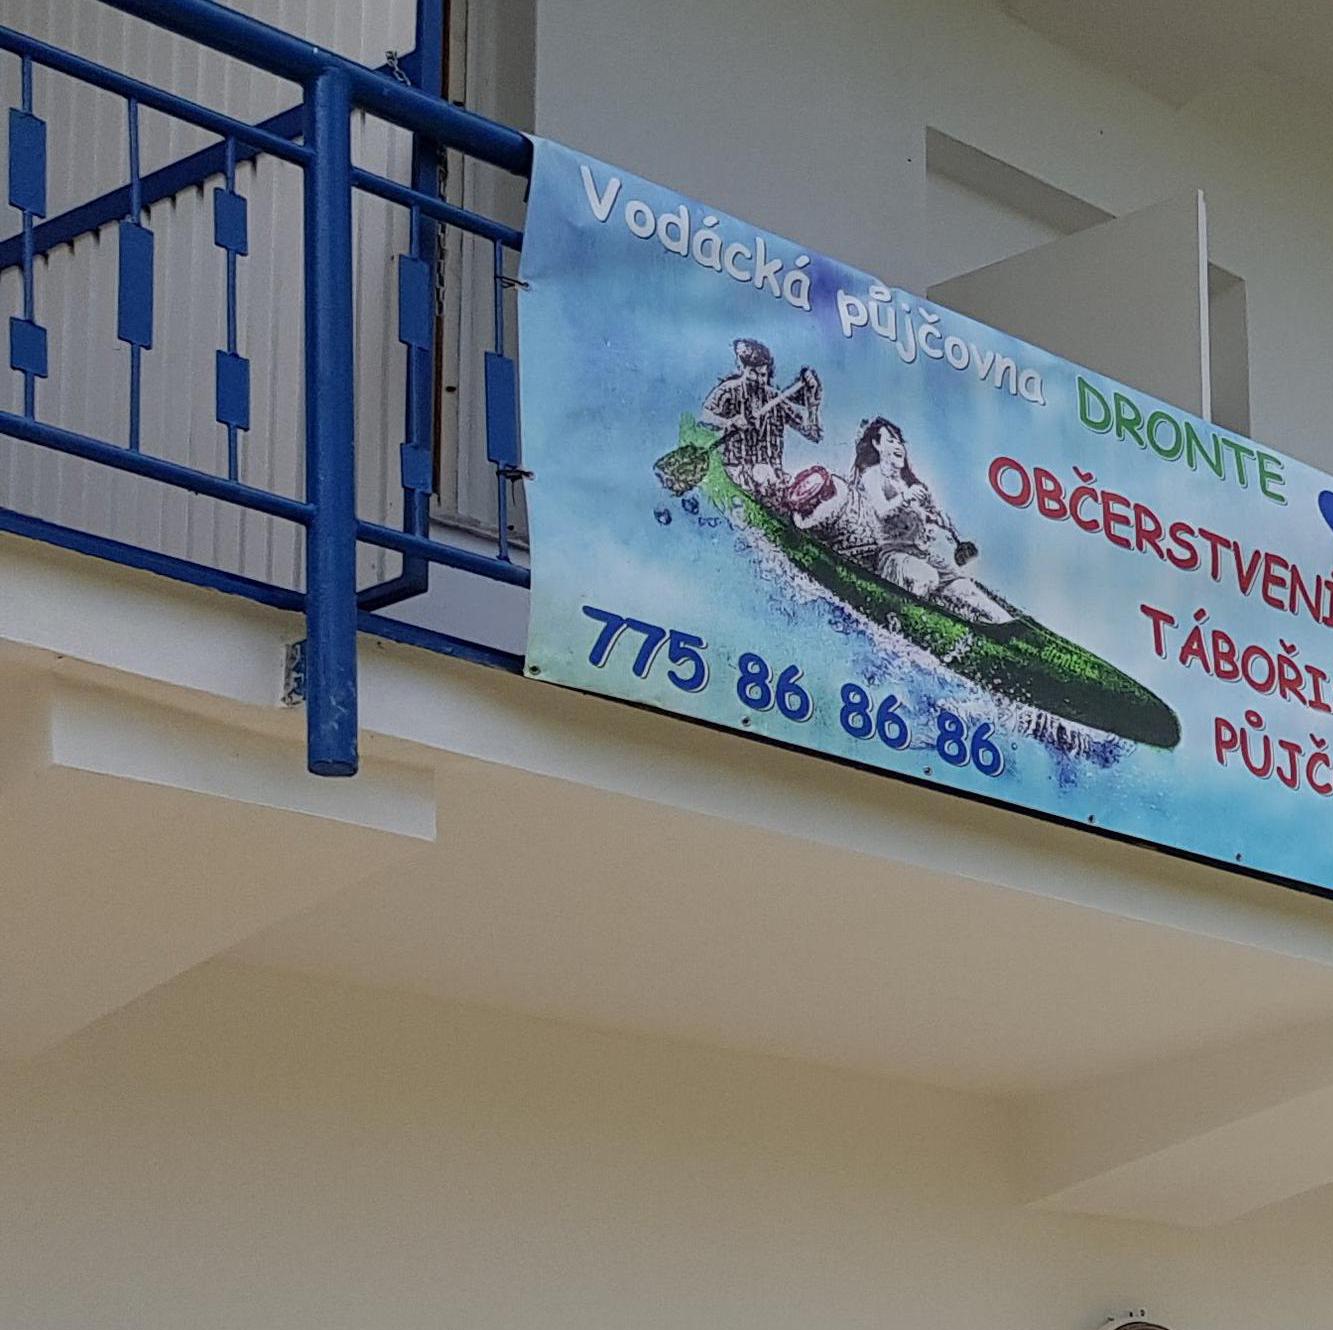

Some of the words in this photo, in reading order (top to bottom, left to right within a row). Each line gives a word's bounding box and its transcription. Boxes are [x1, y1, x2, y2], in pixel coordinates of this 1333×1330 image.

[579, 165, 813, 311] Vodácká
[837, 284, 1046, 406] půjčovna
[1076, 376, 1287, 505] DRONTE
[582, 605, 708, 692] 775
[736, 651, 814, 722] 86
[839, 682, 912, 750] 86
[936, 710, 1005, 777] 86
